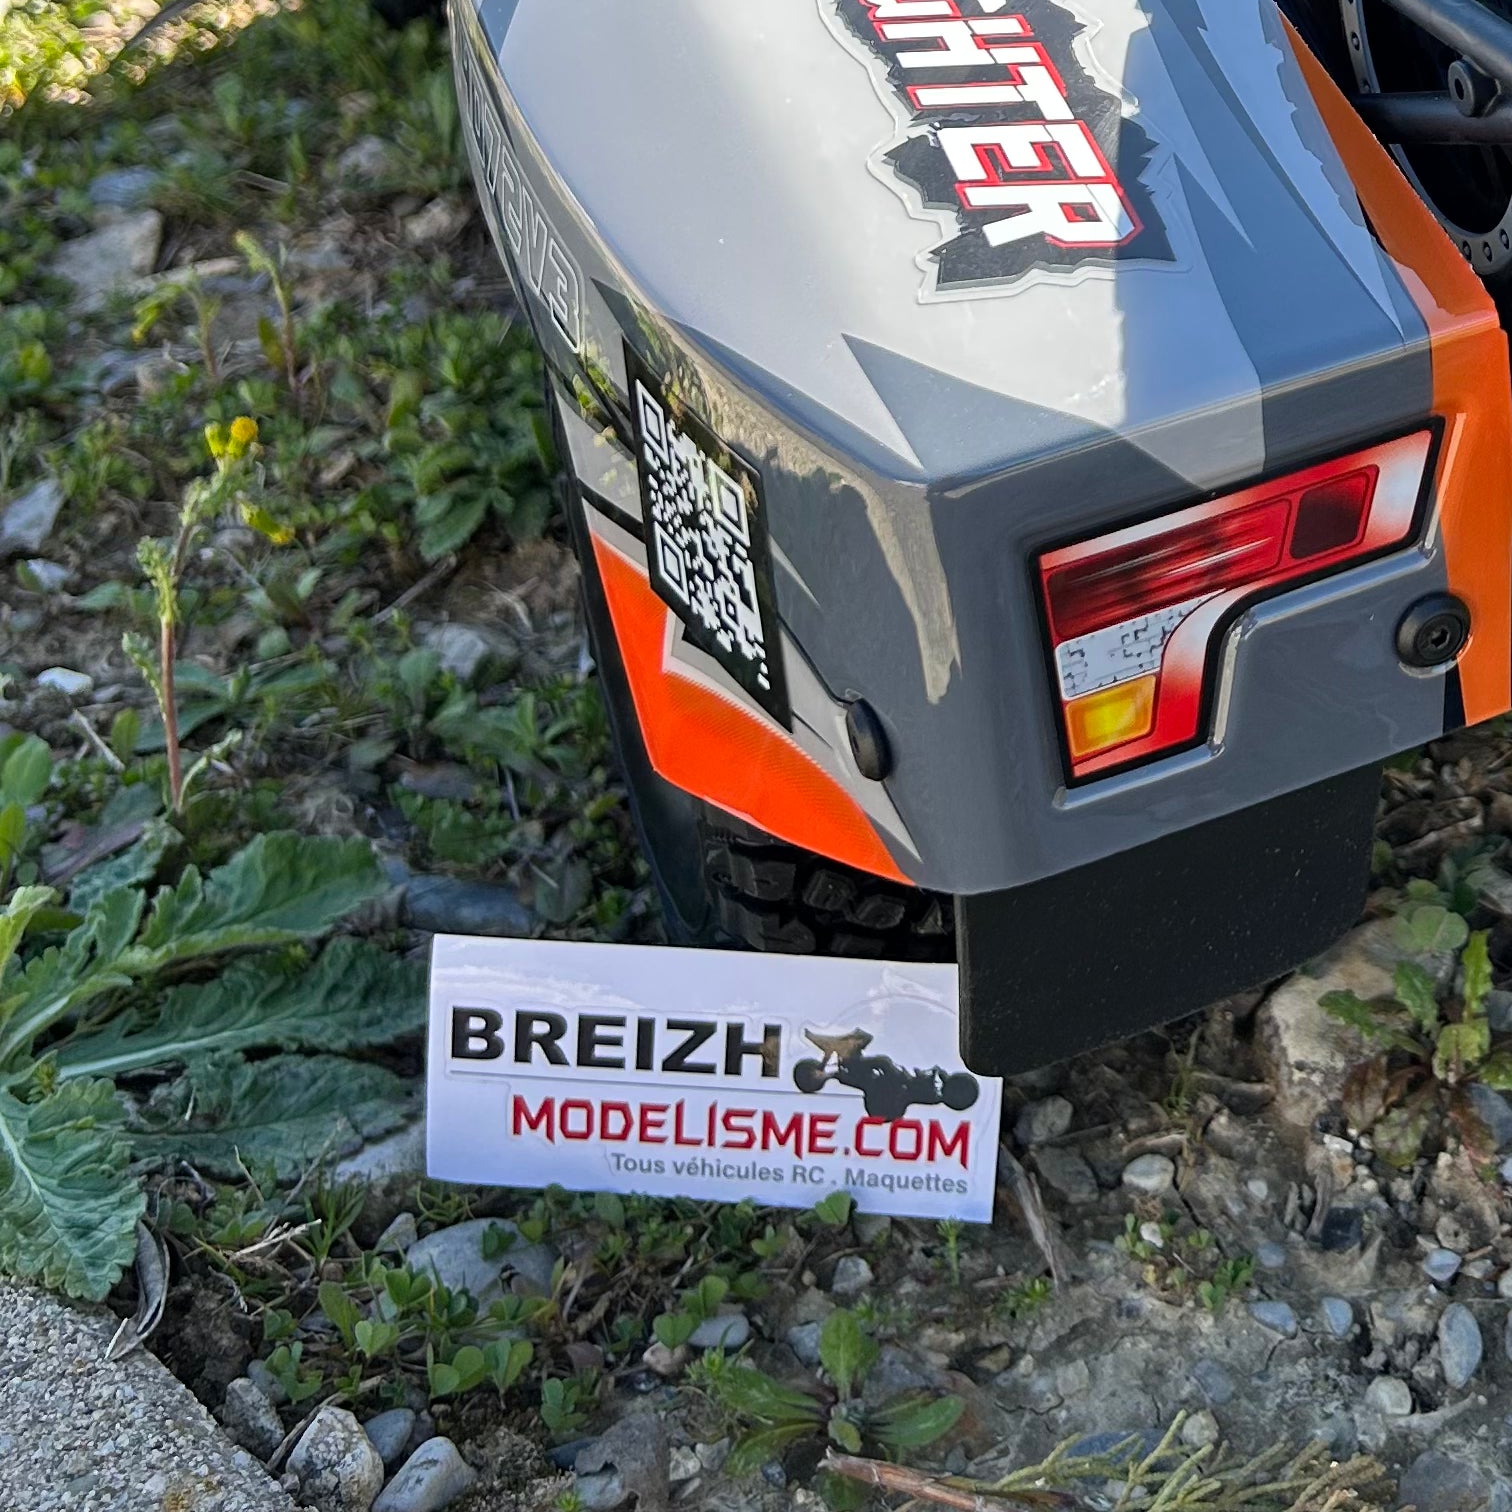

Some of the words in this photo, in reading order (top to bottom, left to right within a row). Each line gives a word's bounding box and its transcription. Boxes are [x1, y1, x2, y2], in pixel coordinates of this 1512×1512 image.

[451, 1005, 783, 1078] BREIZH
[511, 1093, 969, 1170] MODELISME.COM
[611, 1152, 667, 1175] Tous
[672, 1156, 785, 1183] véhicules
[792, 1164, 826, 1185] RC
[844, 1167, 969, 1195] Maquettes
